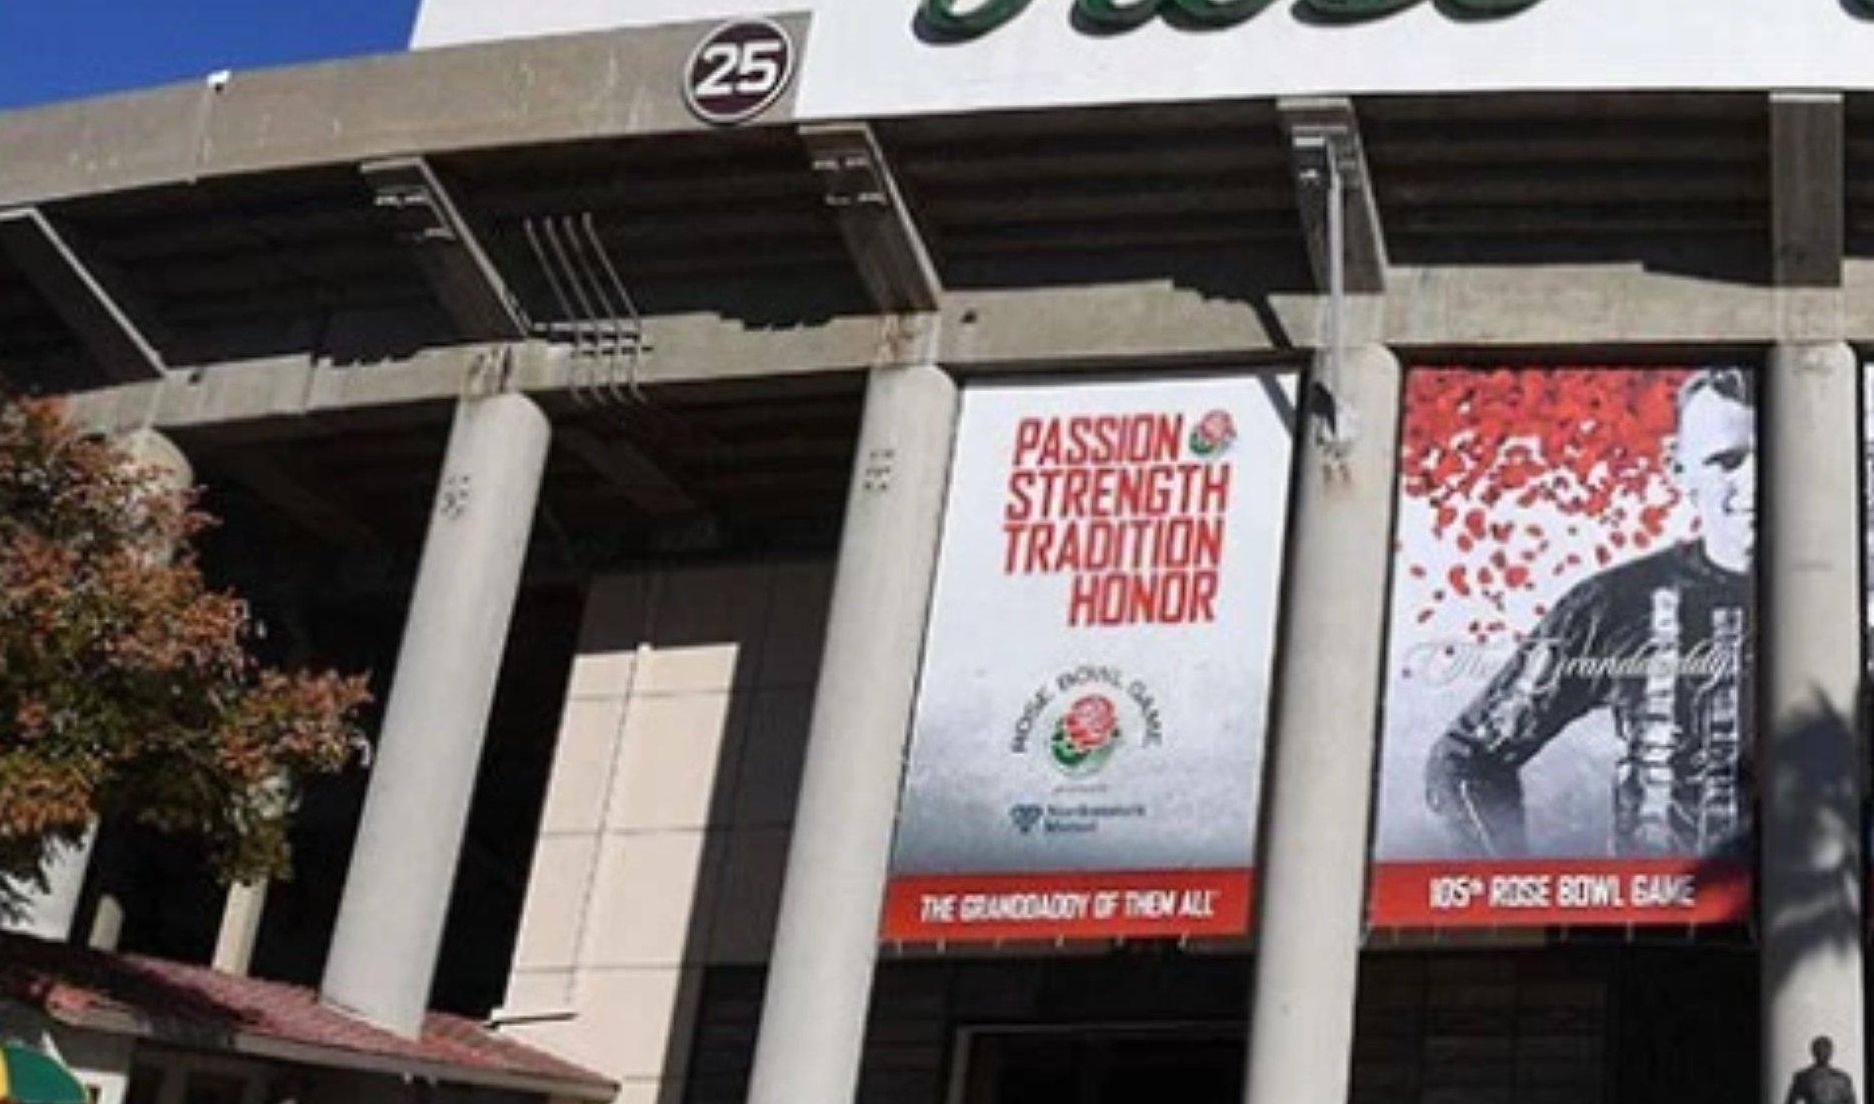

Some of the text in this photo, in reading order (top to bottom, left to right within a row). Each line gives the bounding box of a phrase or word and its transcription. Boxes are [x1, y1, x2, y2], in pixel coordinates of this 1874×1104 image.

[696, 40, 780, 96] 25
[1013, 413, 1183, 466] PASSION
[1006, 464, 1230, 520] STRENGTH
[1004, 517, 1225, 575] TRADITION
[1068, 571, 1219, 627] HONOR
[1010, 666, 1162, 753] ROSE BOWL GAME
[921, 889, 1215, 922] THE GRANDDADDY OF THEM ALL
[1489, 874, 1550, 908] ROSE
[1557, 874, 1624, 908] BOWL
[1631, 874, 1696, 907] GAME
